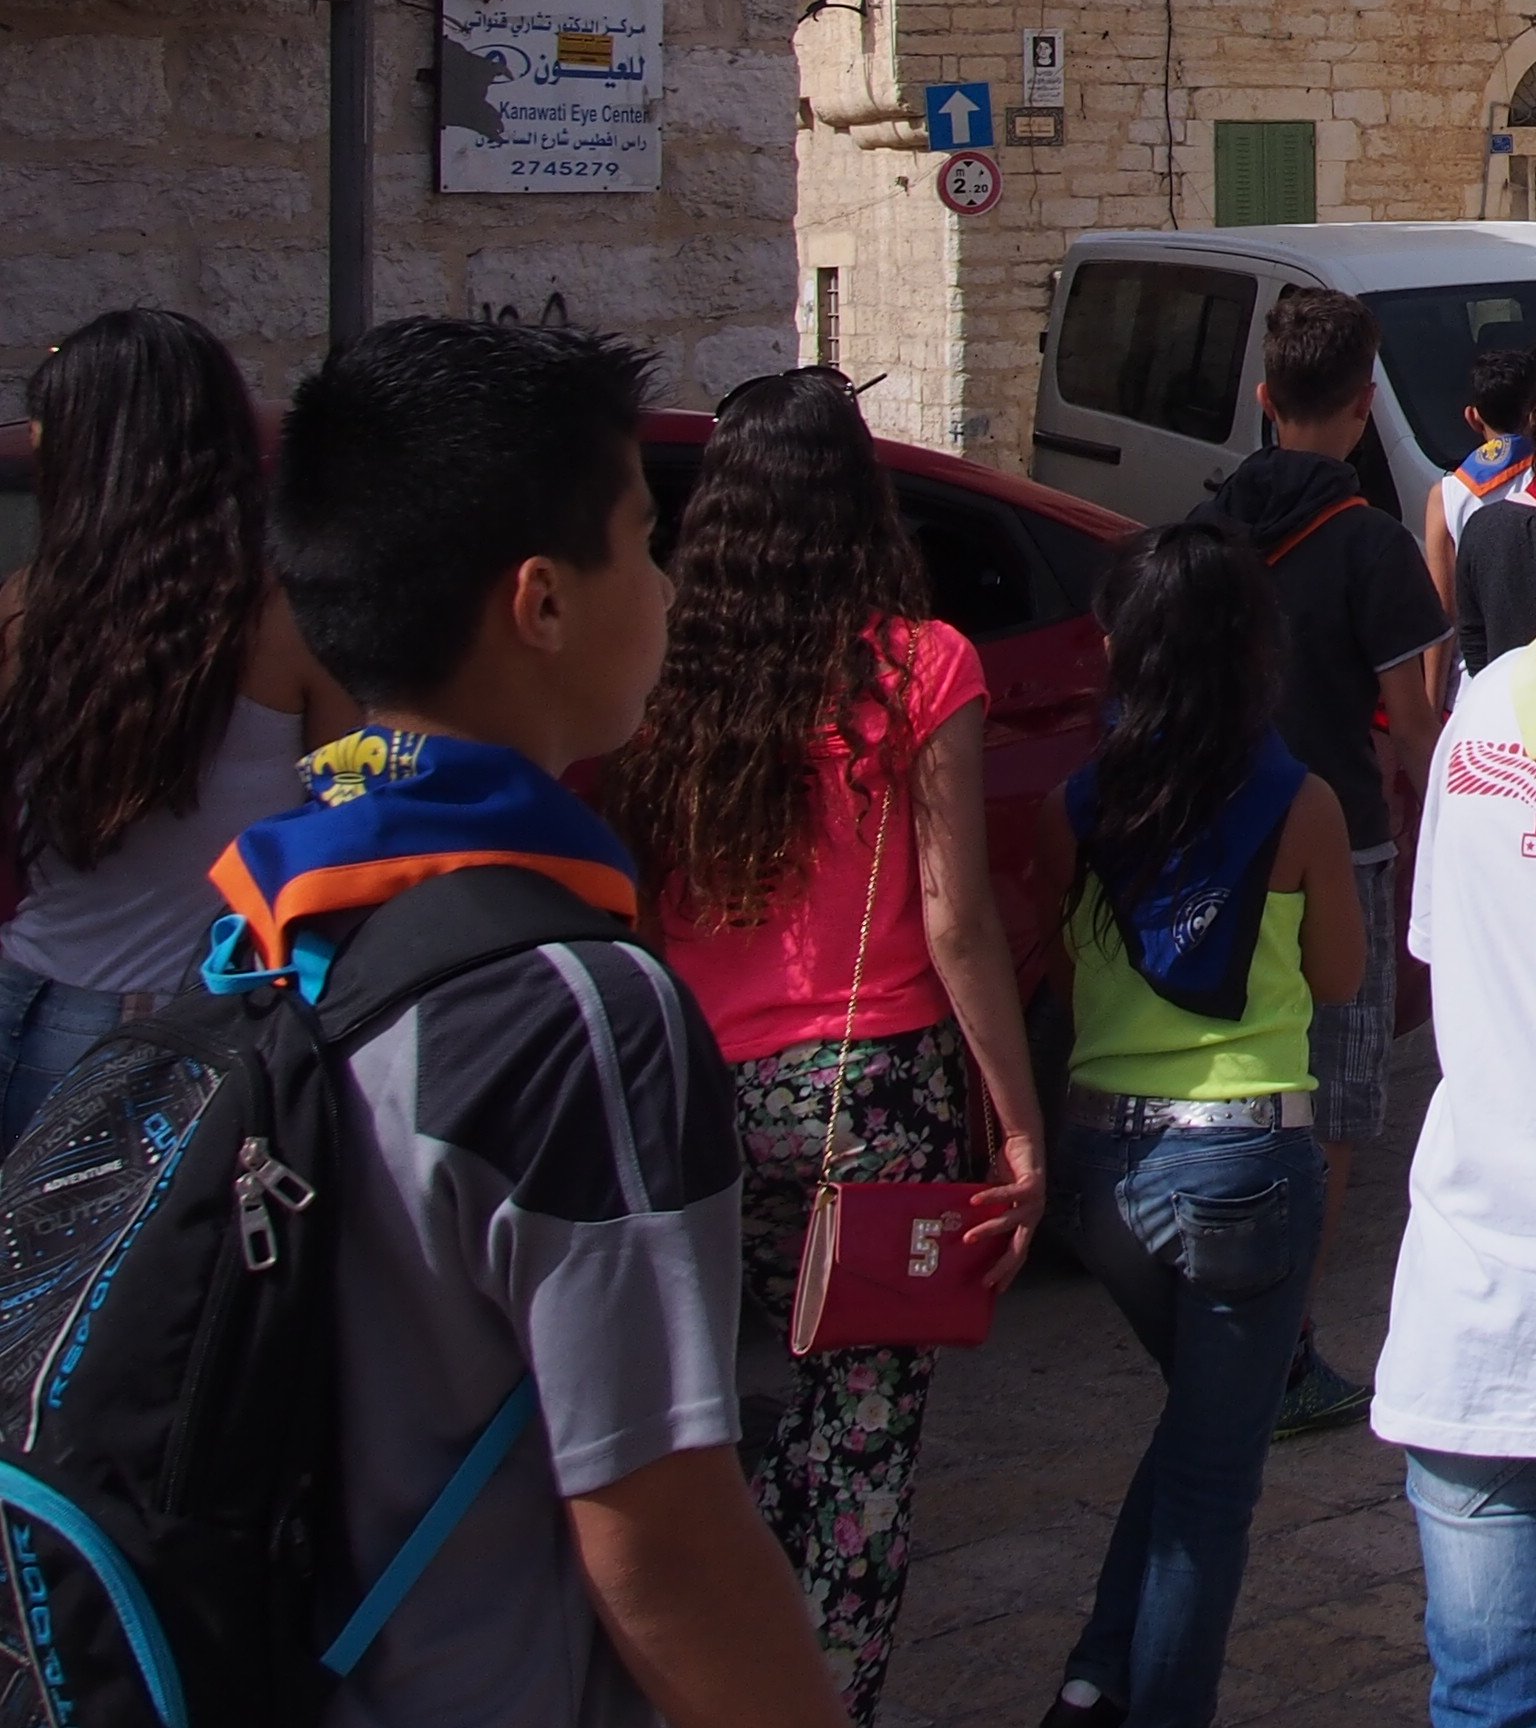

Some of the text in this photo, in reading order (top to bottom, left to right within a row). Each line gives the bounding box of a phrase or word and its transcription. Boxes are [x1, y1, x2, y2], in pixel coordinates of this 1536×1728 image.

[555, 16, 599, 35] الدكتور
[603, 17, 646, 37] مركز
[500, 101, 649, 126] Kanawati Eye Center
[541, 128, 569, 150] شارع
[621, 135, 647, 151] راس
[511, 160, 619, 176] 2745279
[953, 178, 988, 194] 2.20
[42, 1158, 124, 1194] ADVENTURE
